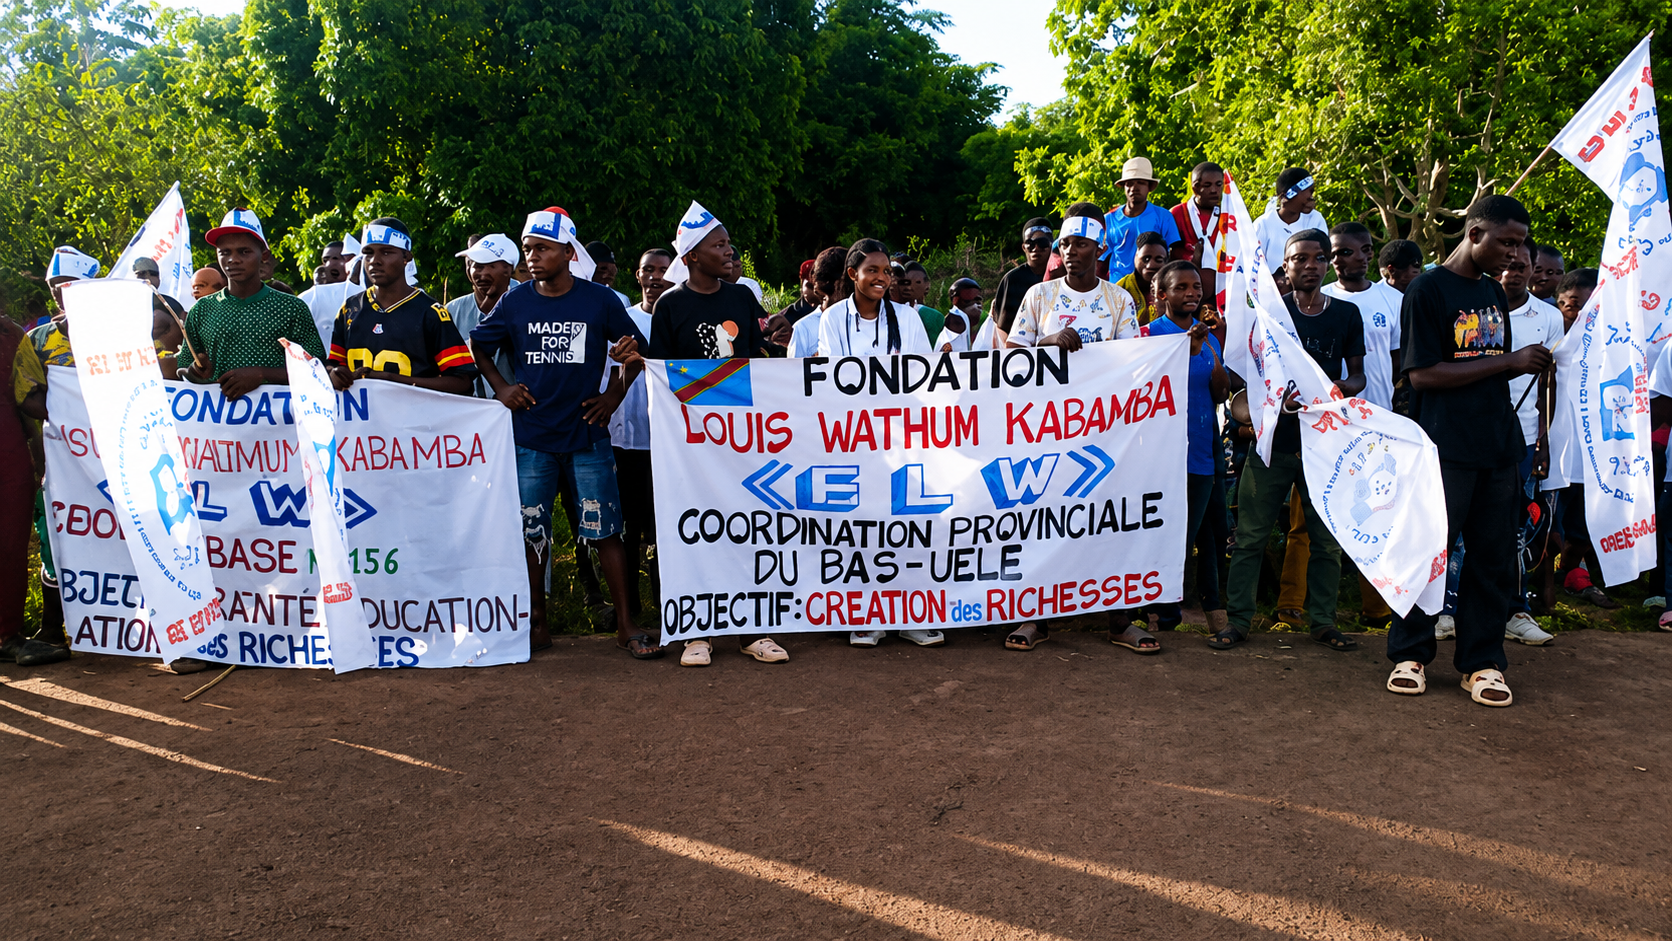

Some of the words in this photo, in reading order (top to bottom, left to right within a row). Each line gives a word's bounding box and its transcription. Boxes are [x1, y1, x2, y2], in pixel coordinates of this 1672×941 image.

[527, 321, 571, 335] MADE
[541, 336, 569, 351] FOR
[524, 351, 574, 365] TENNIS
[803, 348, 1070, 397] FONDATION
[164, 387, 370, 426] ONDATN
[683, 403, 793, 454] LOUIS
[817, 405, 979, 454] WATHUM
[1006, 374, 1177, 445] KABAMBA
[336, 433, 487, 472] KABAMBA
[677, 508, 933, 549] COORDINATION
[948, 491, 1164, 547] PROVINCIALE
[205, 535, 298, 574] BASE
[348, 547, 399, 575] 156
[753, 549, 798, 587] DU
[360, 594, 530, 634] DUCATION-
[663, 590, 803, 636] OBJECTIF:
[805, 589, 947, 626] CREATION
[951, 597, 983, 624] des
[986, 570, 1164, 622] RICHESSES
[239, 631, 420, 668] RICHEES
